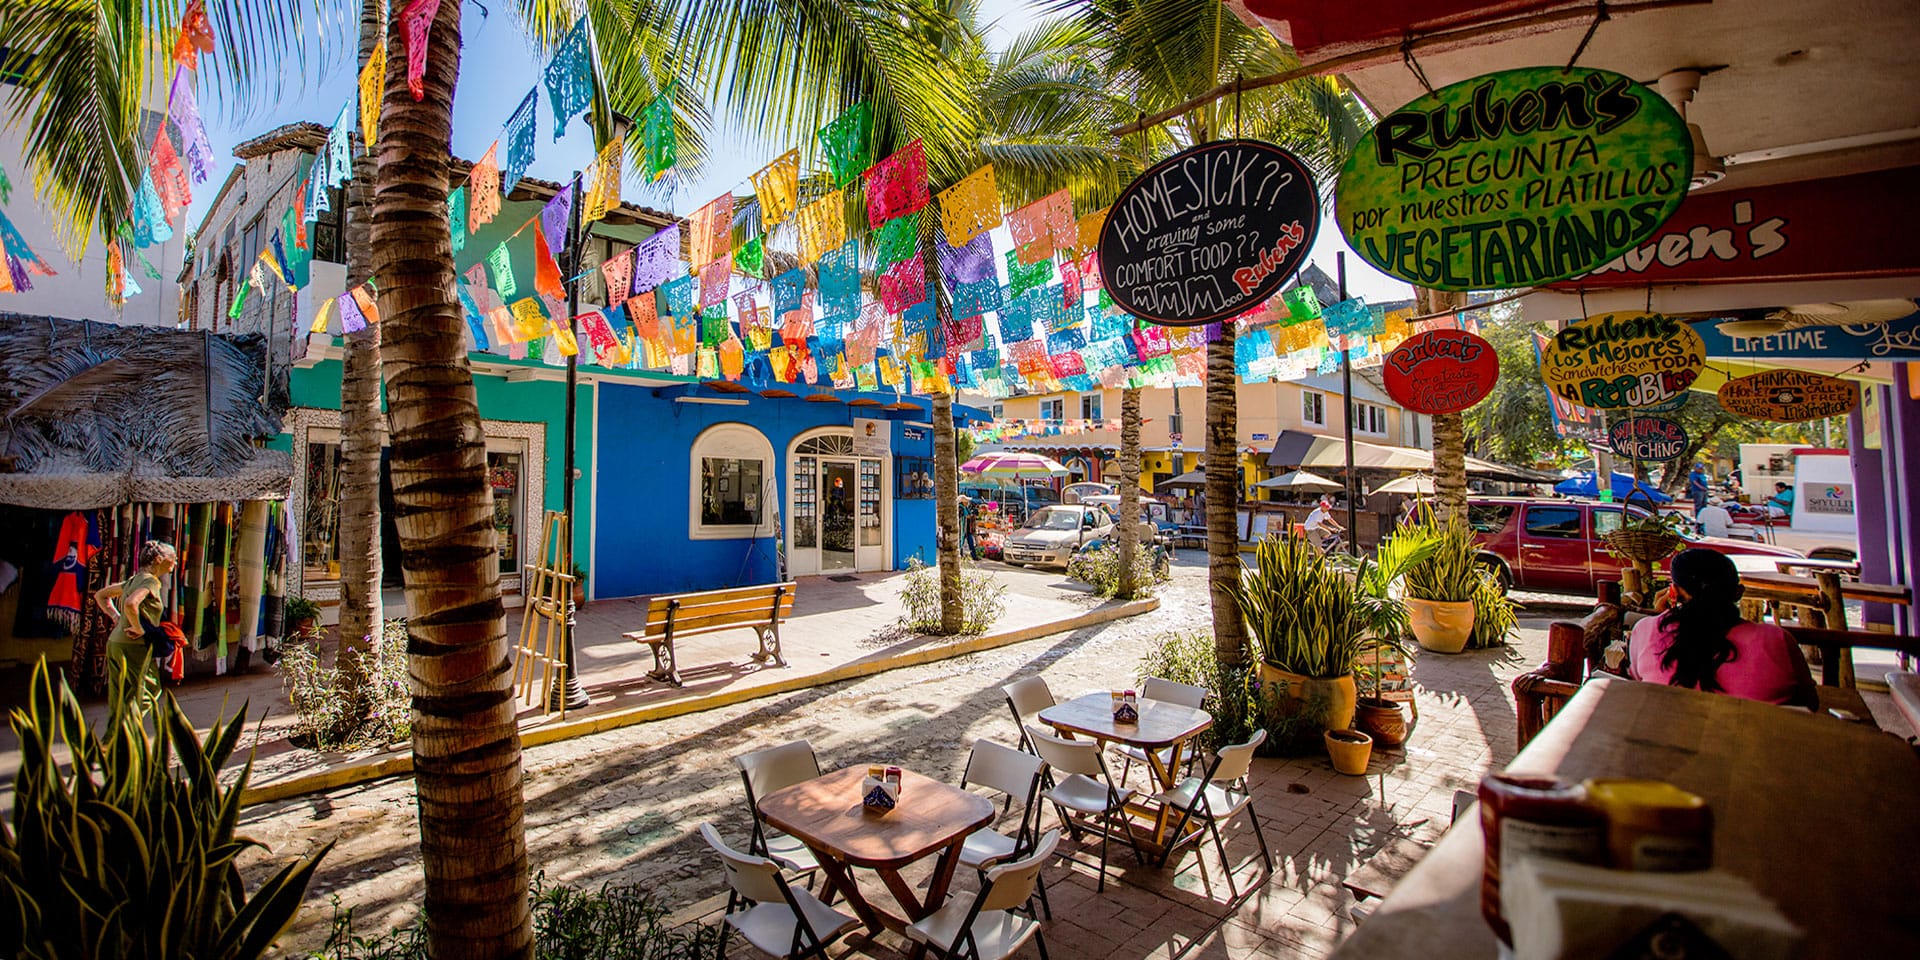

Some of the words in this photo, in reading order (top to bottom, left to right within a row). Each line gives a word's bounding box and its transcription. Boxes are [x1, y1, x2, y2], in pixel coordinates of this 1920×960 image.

[1372, 72, 1642, 166] Ruben's
[1400, 134, 1598, 194] PREGUNTA
[1113, 149, 1293, 253] HOMESICK??
[1351, 205, 1390, 235] por
[1400, 190, 1509, 223] nuestros
[1524, 162, 1678, 209] PLATILLOS
[1192, 209, 1211, 223] and
[1146, 223, 1200, 253] craving
[1206, 213, 1246, 236] some
[1115, 250, 1184, 289] COMFORT
[1232, 219, 1305, 296] Ruben's
[1556, 315, 1681, 352] Ruben's
[1731, 330, 1828, 353] LIFETIME
[1391, 332, 1483, 375] Ruben's
[1549, 361, 1637, 382] Sandwiches
[1649, 353, 1702, 371] TODA
[1553, 352, 1583, 368] Los
[1589, 338, 1684, 365] Mejores
[1556, 383, 1579, 401] LA
[1806, 385, 1833, 394] CALL
[1811, 388, 1853, 401] FREE!
[1732, 404, 1775, 418] Tourist
[1779, 400, 1854, 420] Information
[1613, 418, 1682, 441] WHALE
